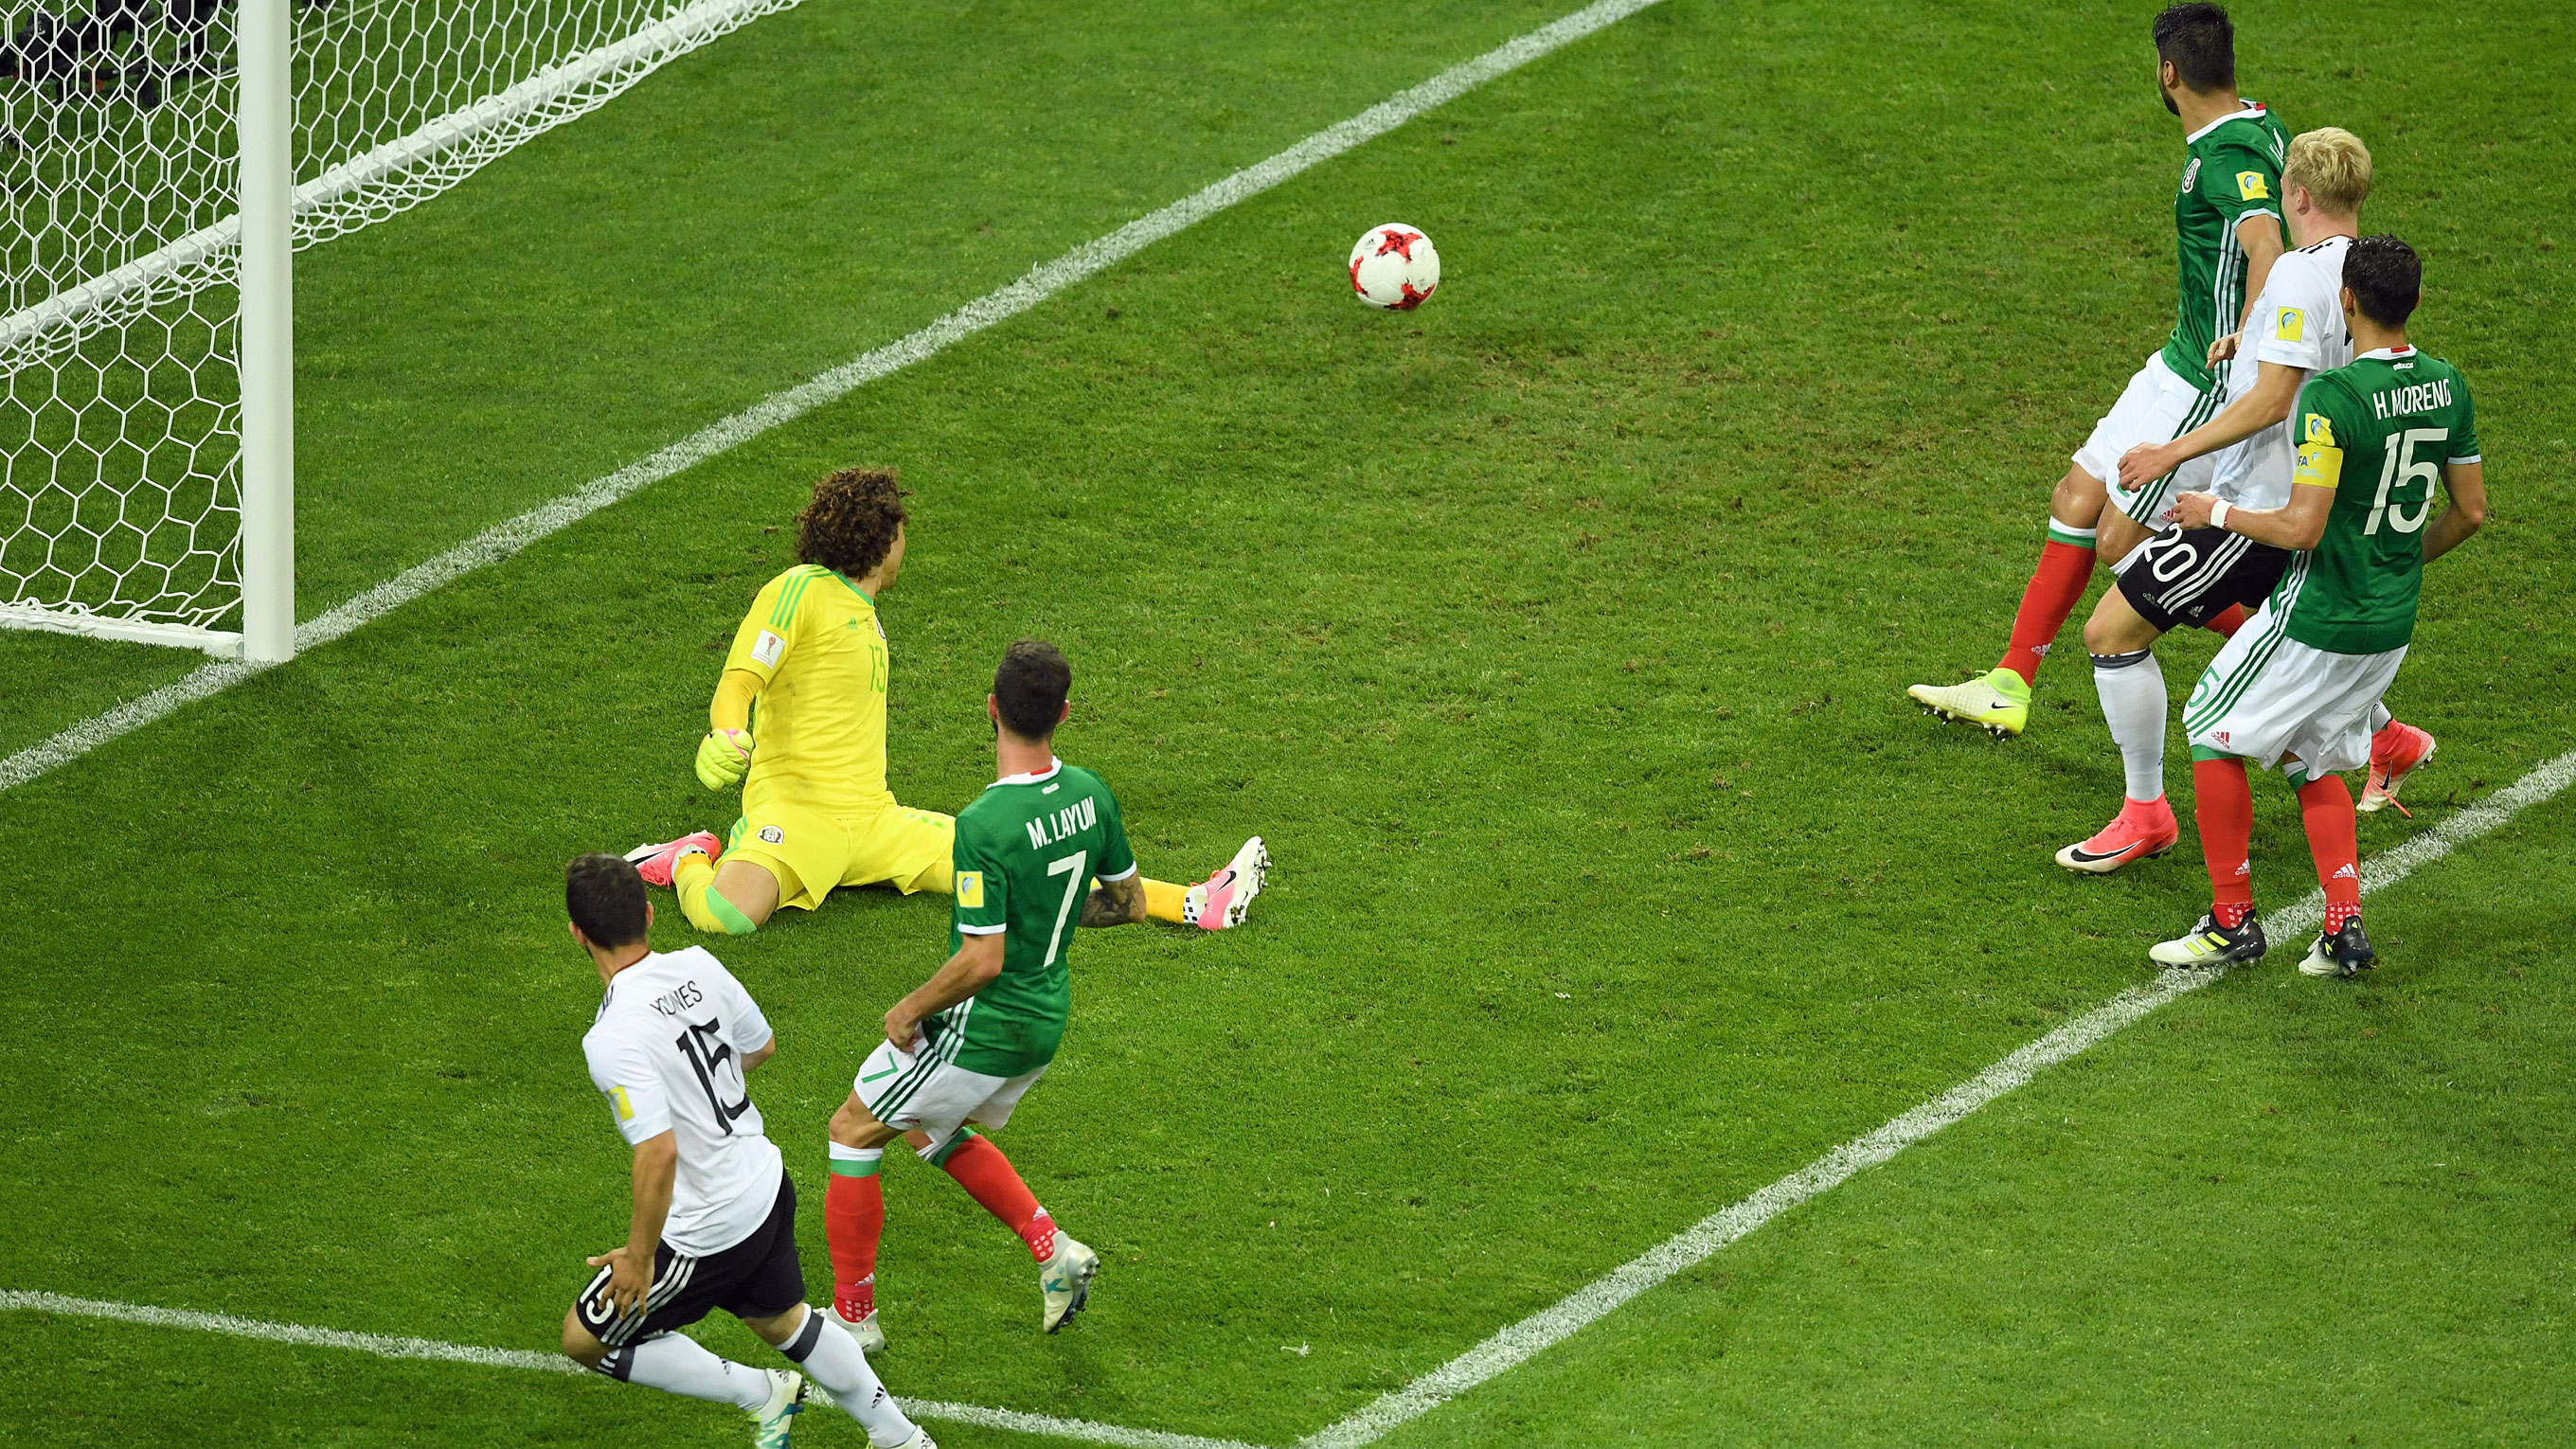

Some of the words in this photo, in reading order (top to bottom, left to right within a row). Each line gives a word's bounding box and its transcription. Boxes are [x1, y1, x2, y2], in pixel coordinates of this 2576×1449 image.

[2364, 427, 2449, 536] 15
[2143, 522, 2197, 582] 20
[1025, 816, 1052, 847] M.
[1043, 850, 1087, 968] 7
[675, 1016, 751, 1136] 15
[862, 1050, 900, 1084] 7
